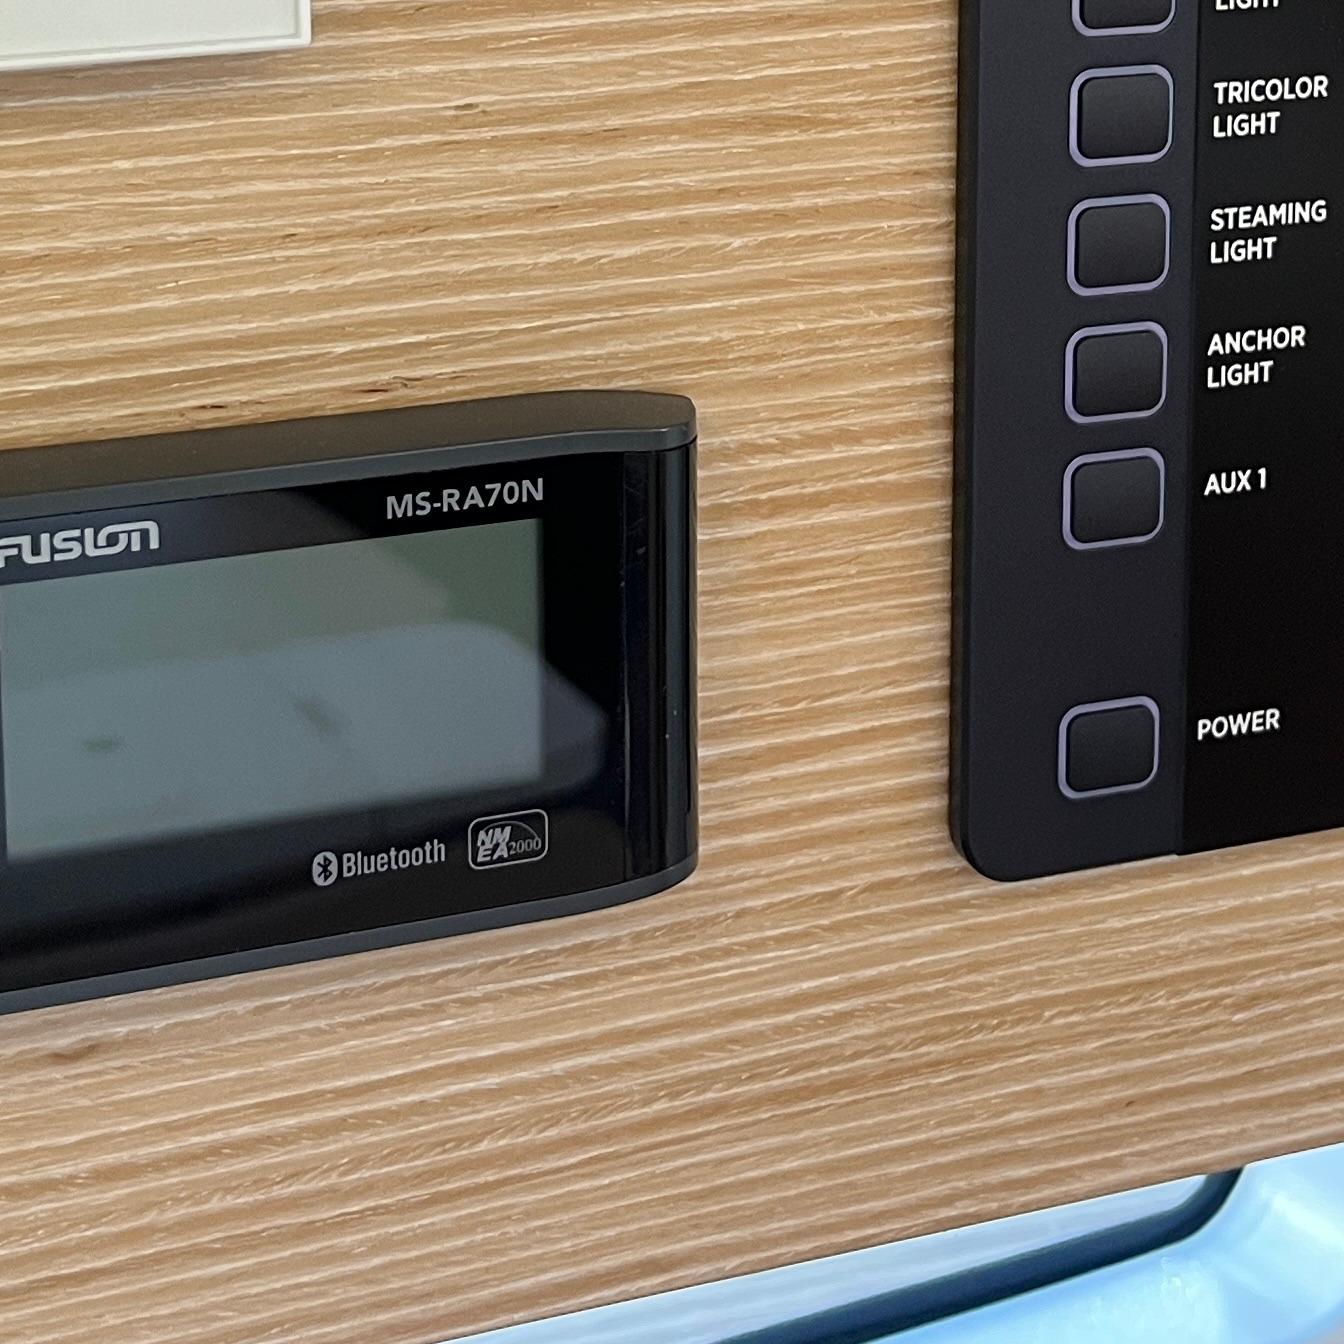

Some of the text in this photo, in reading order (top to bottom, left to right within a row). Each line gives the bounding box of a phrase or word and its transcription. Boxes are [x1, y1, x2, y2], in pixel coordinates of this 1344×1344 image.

[1213, 75, 1329, 105] TRICOLOR
[1213, 111, 1281, 138] LIGHT
[1210, 199, 1327, 231] STEAMING
[1210, 236, 1278, 264] LIGHT
[1207, 325, 1306, 356] ANCHOR
[1207, 359, 1274, 389] LIGHT
[1203, 467, 1267, 496] AUX 1
[386, 477, 544, 520] MS-RA70N
[1197, 708, 1280, 741] POWER
[342, 838, 446, 878] Bluetooth
